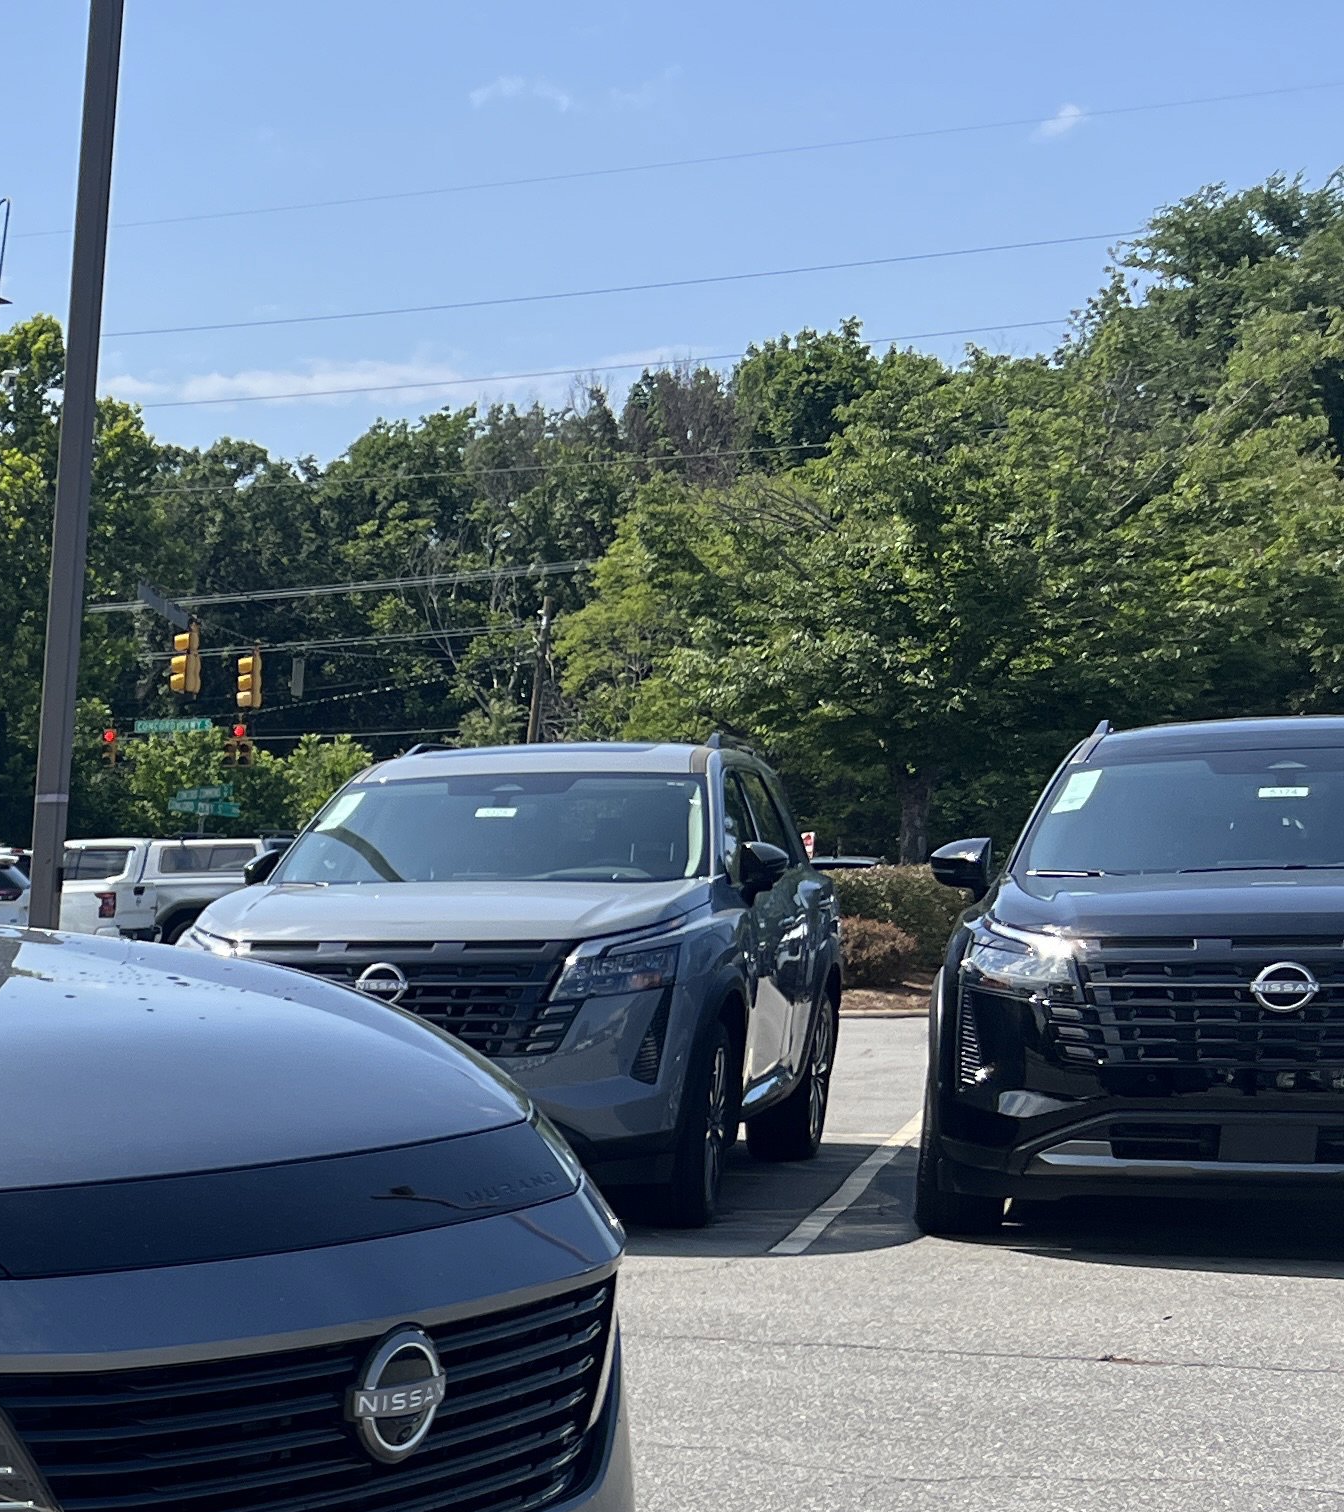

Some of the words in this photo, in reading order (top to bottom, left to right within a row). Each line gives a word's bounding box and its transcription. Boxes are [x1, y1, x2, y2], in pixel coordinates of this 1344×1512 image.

[356, 981, 408, 990] NISSAN
[1251, 983, 1319, 993] NISSAN
[358, 1382, 445, 1414] NISSAN
